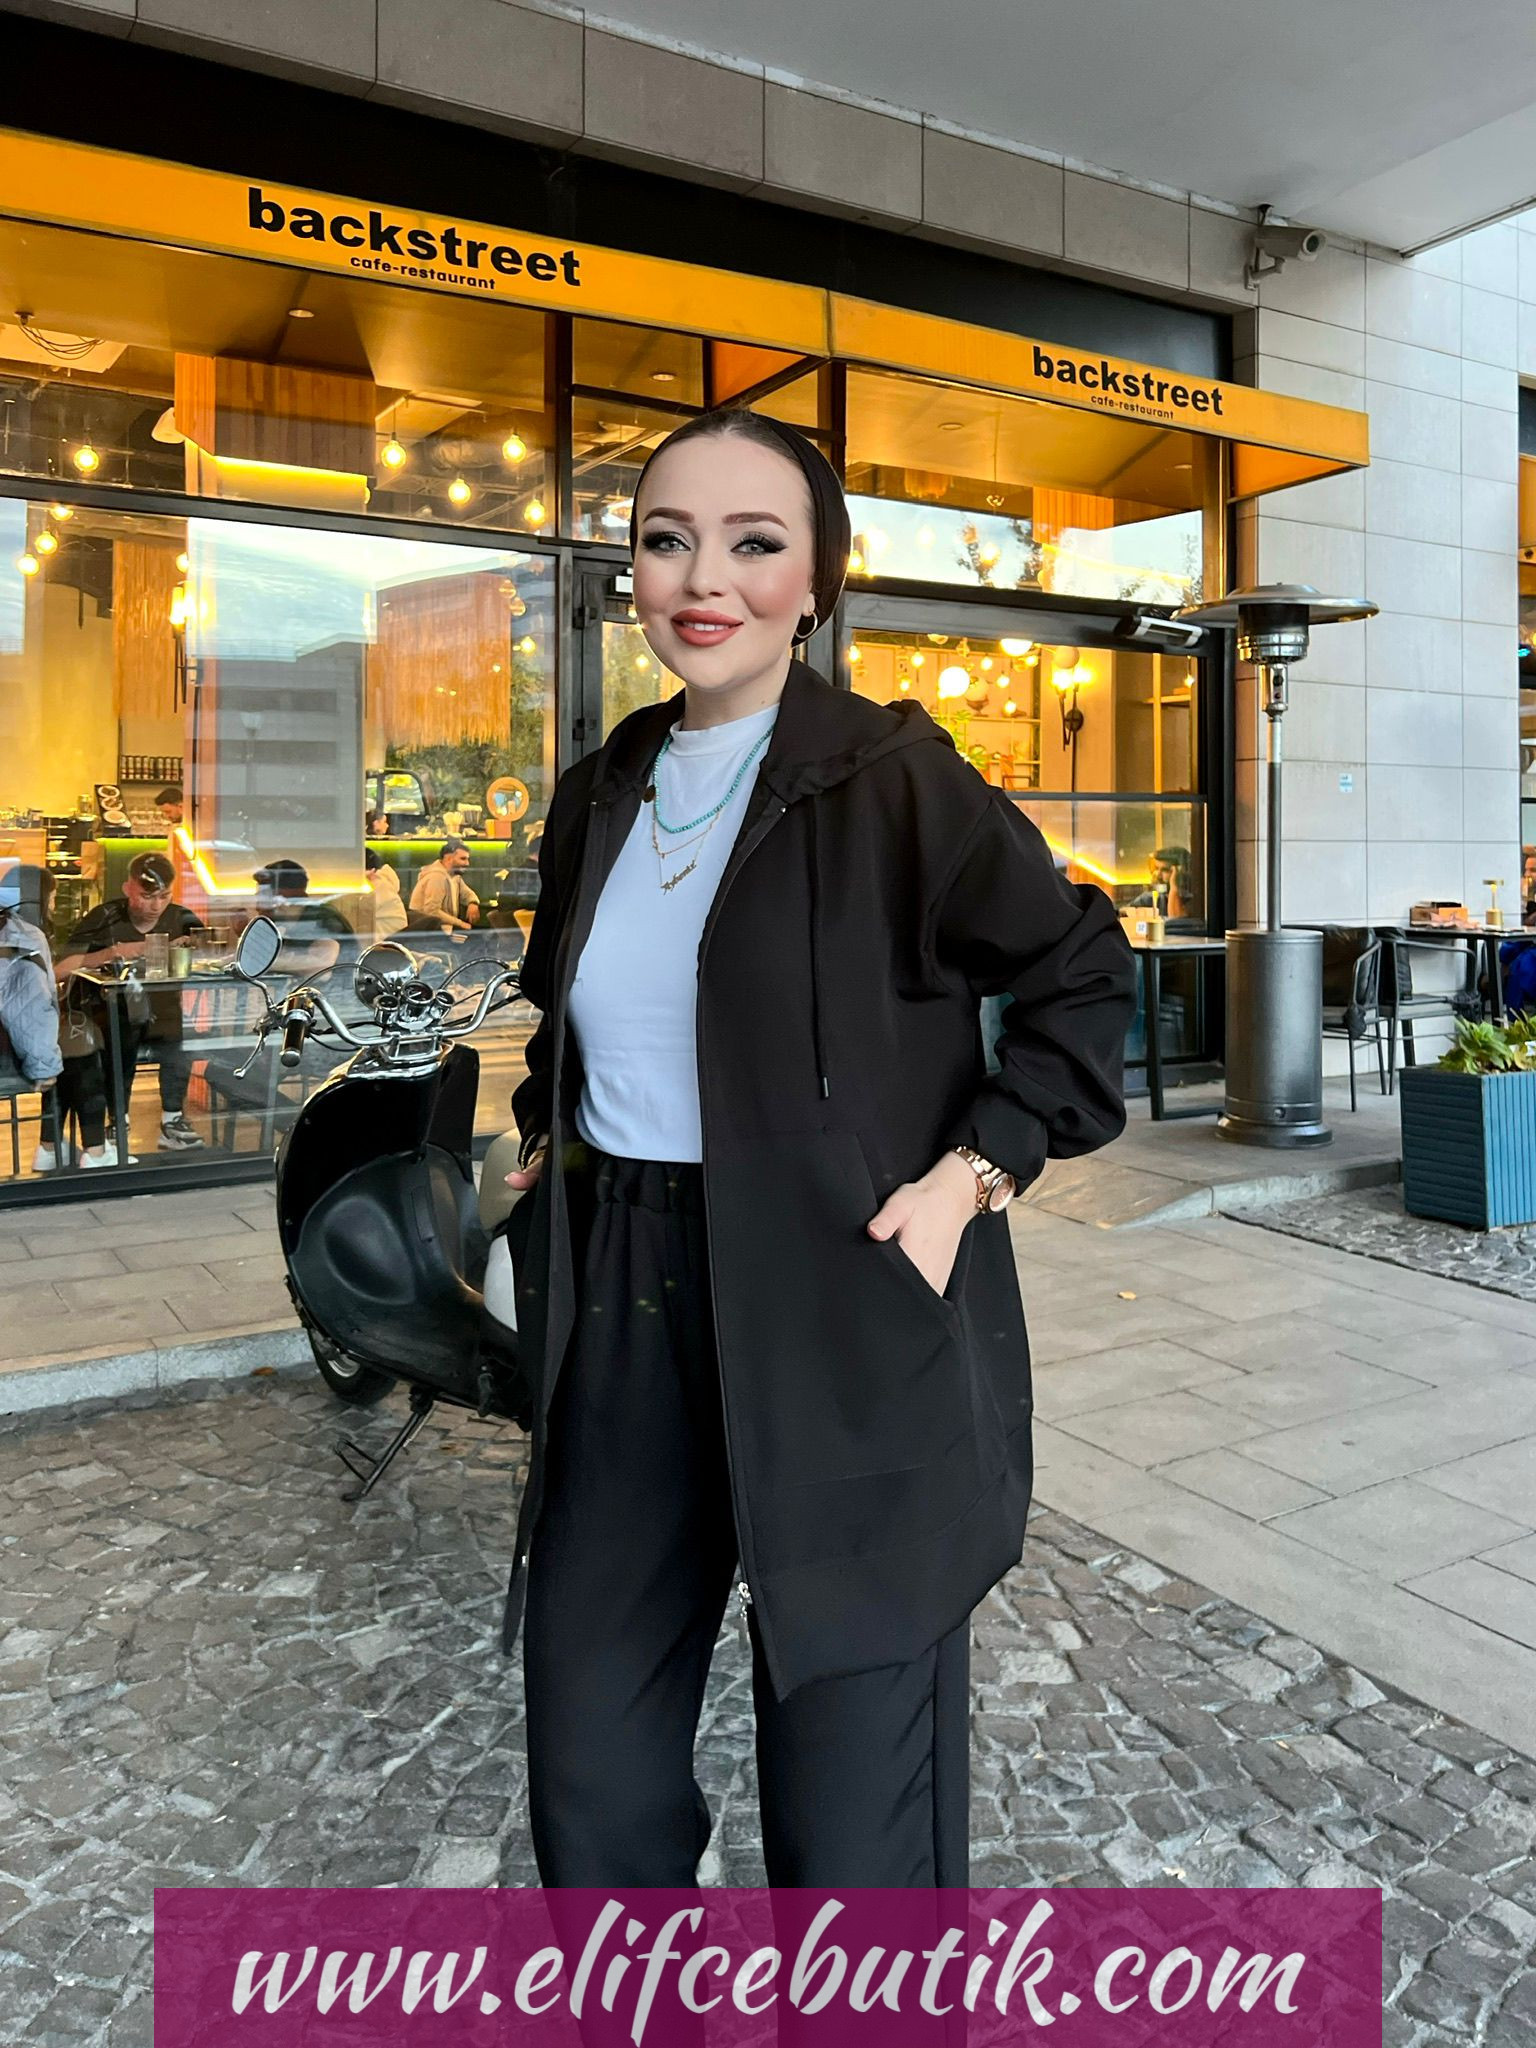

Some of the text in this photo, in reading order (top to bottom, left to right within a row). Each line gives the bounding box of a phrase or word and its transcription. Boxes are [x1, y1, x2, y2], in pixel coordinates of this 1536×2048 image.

[247, 186, 581, 287] backstreet
[350, 256, 496, 290] cafe-restaurant
[1033, 345, 1224, 416] backstreet
[1091, 395, 1174, 420] cafe-restaurant
